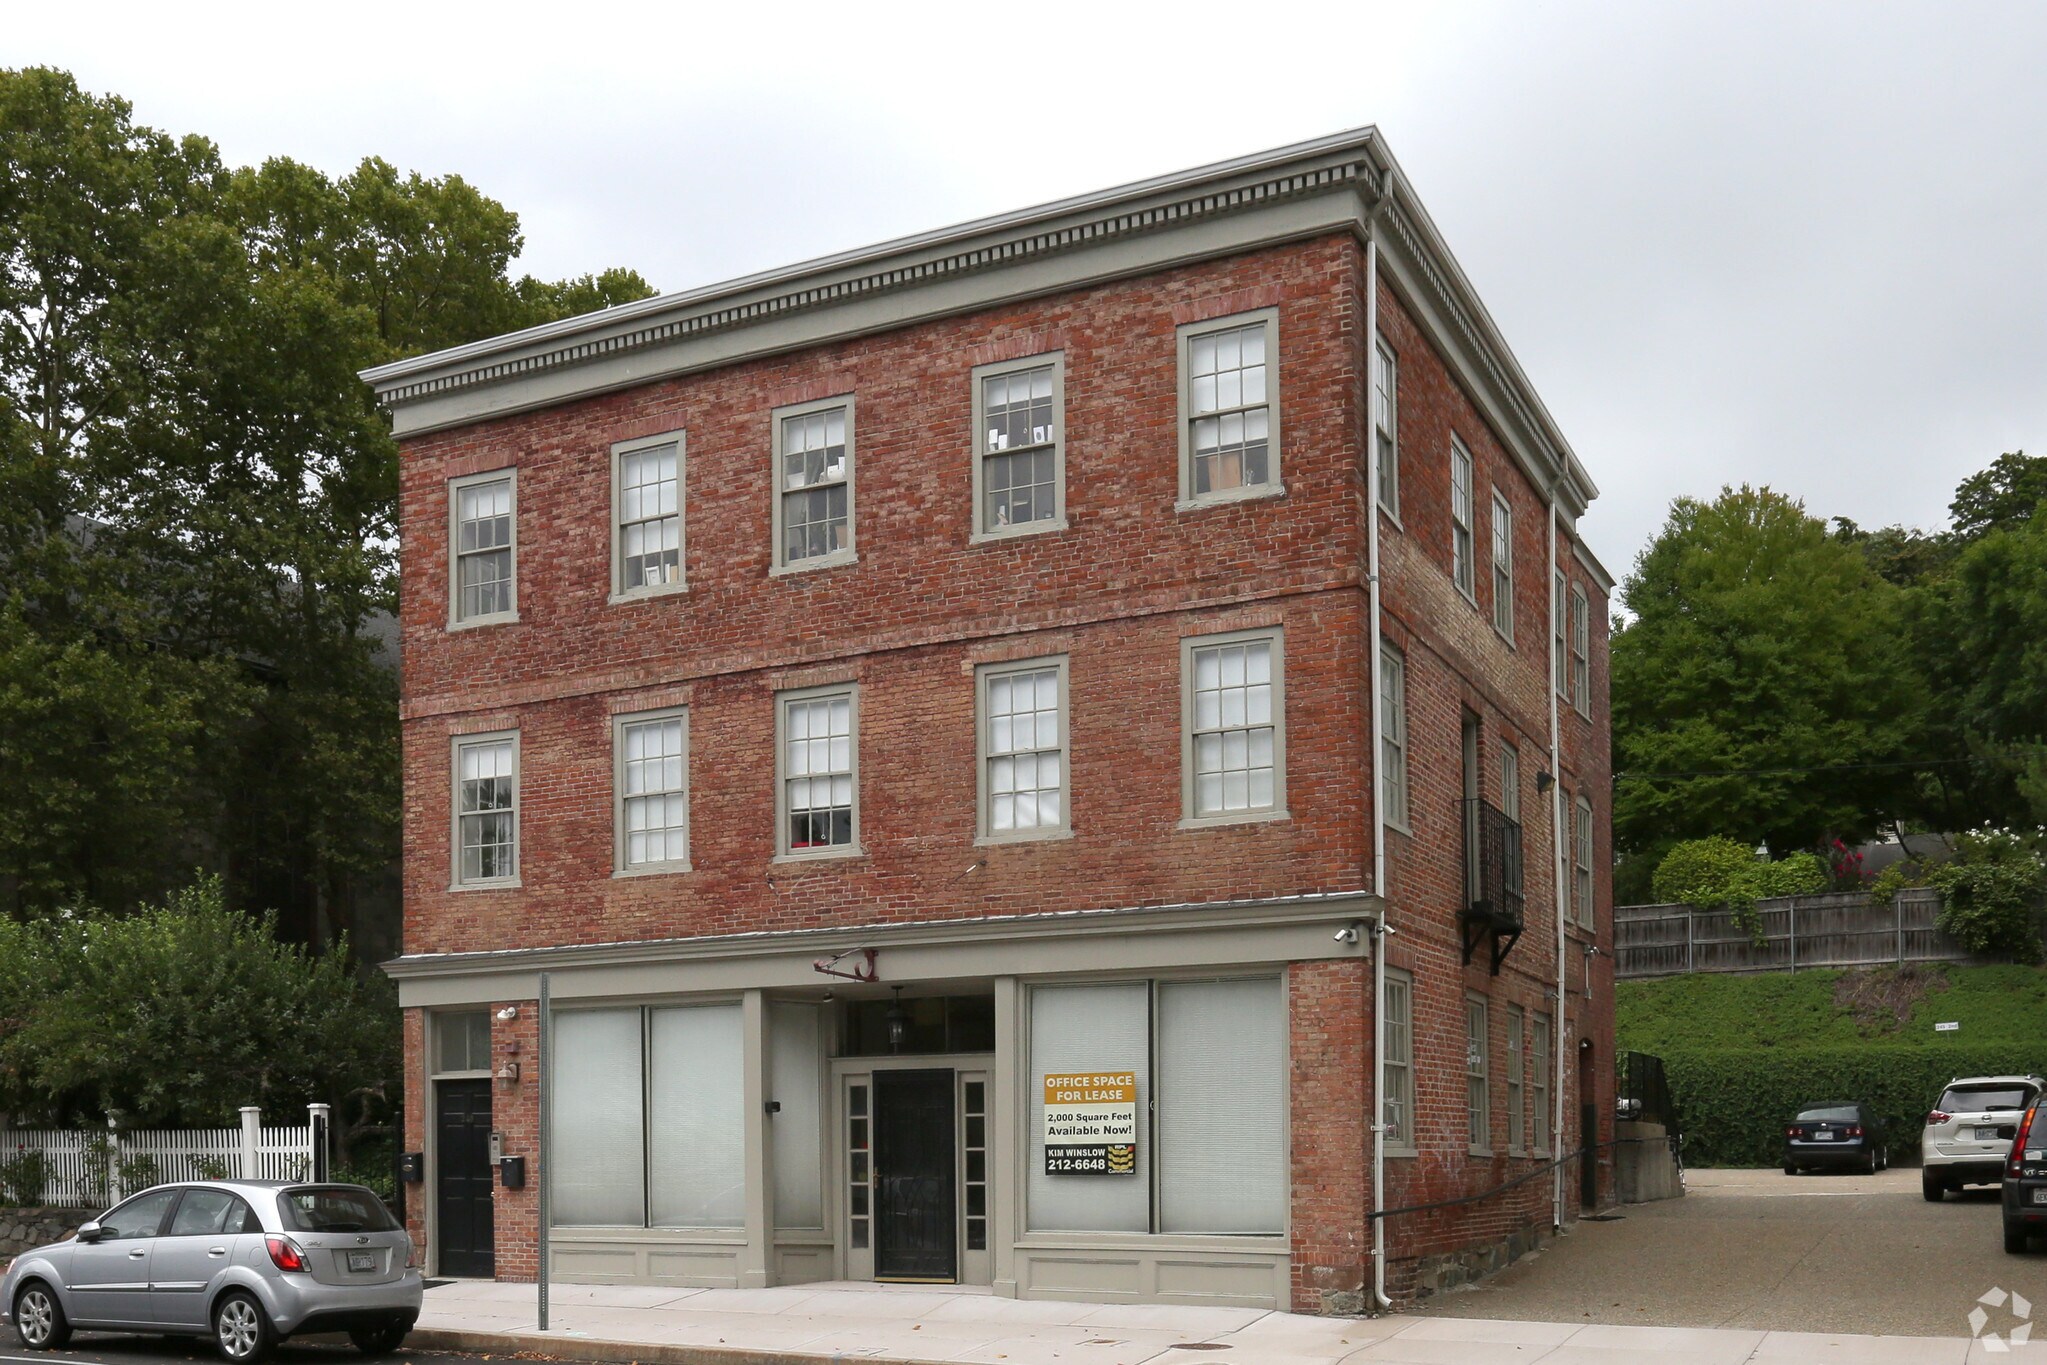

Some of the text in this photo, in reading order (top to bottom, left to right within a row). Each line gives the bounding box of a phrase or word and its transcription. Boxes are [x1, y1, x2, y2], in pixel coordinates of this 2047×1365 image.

[1046, 1075, 1133, 1088] OFFICE SPACE
[1056, 1090, 1123, 1101] FOR LEASE
[1047, 1112, 1132, 1123] 2,000 Square Feet
[1048, 1125, 1132, 1136] Available Now!
[1048, 1148, 1106, 1157] KIM WINSLOW
[1048, 1159, 1106, 1170] 212-6648
[2024, 1169, 2035, 1177] VT
